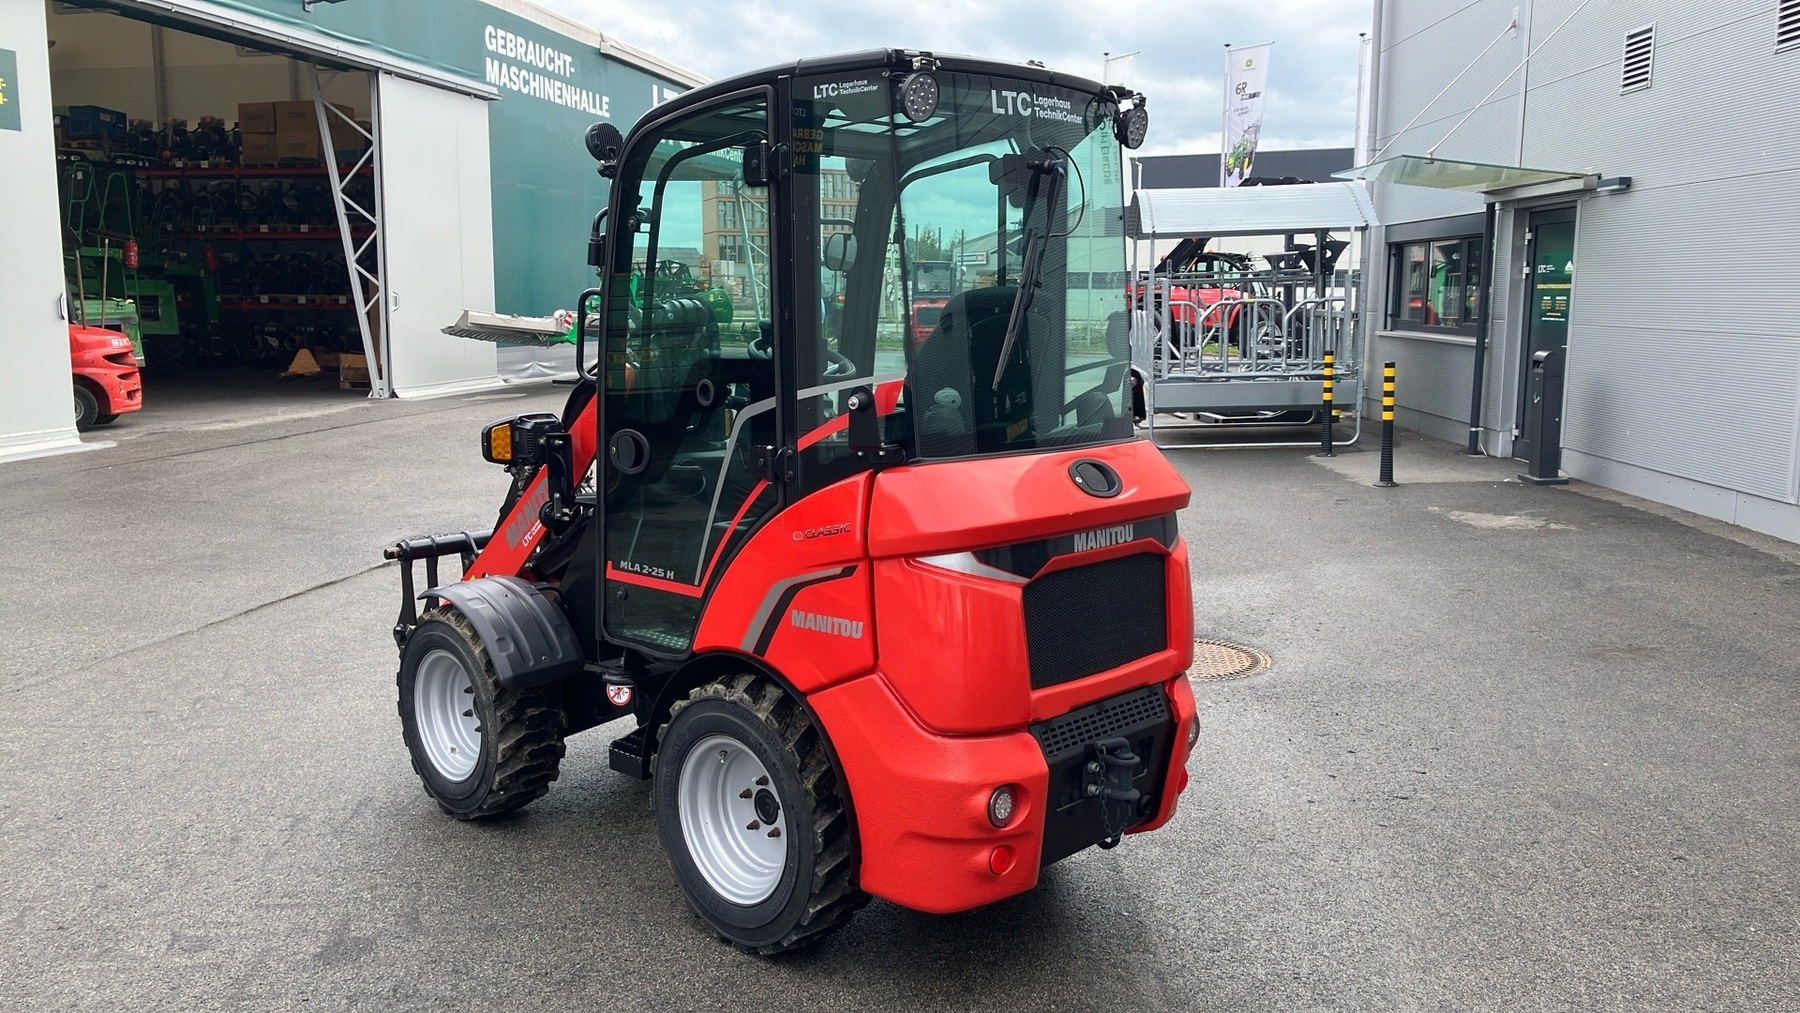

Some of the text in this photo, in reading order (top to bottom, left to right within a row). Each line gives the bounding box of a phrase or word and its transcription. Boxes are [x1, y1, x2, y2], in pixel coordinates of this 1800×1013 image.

[484, 24, 575, 78] GEBRAUCHT-
[485, 56, 610, 118] MASCHINENHALLE
[813, 83, 838, 99] LTC
[1235, 81, 1248, 95] 6R
[991, 89, 1071, 117] LTC Lagerhaus
[1034, 107, 1083, 124] TechnikCenter
[804, 523, 852, 539] CLASSIC
[1074, 523, 1134, 553] MANITOU
[620, 560, 675, 580] MLA 2-25 H
[791, 609, 864, 639] MANITOU
